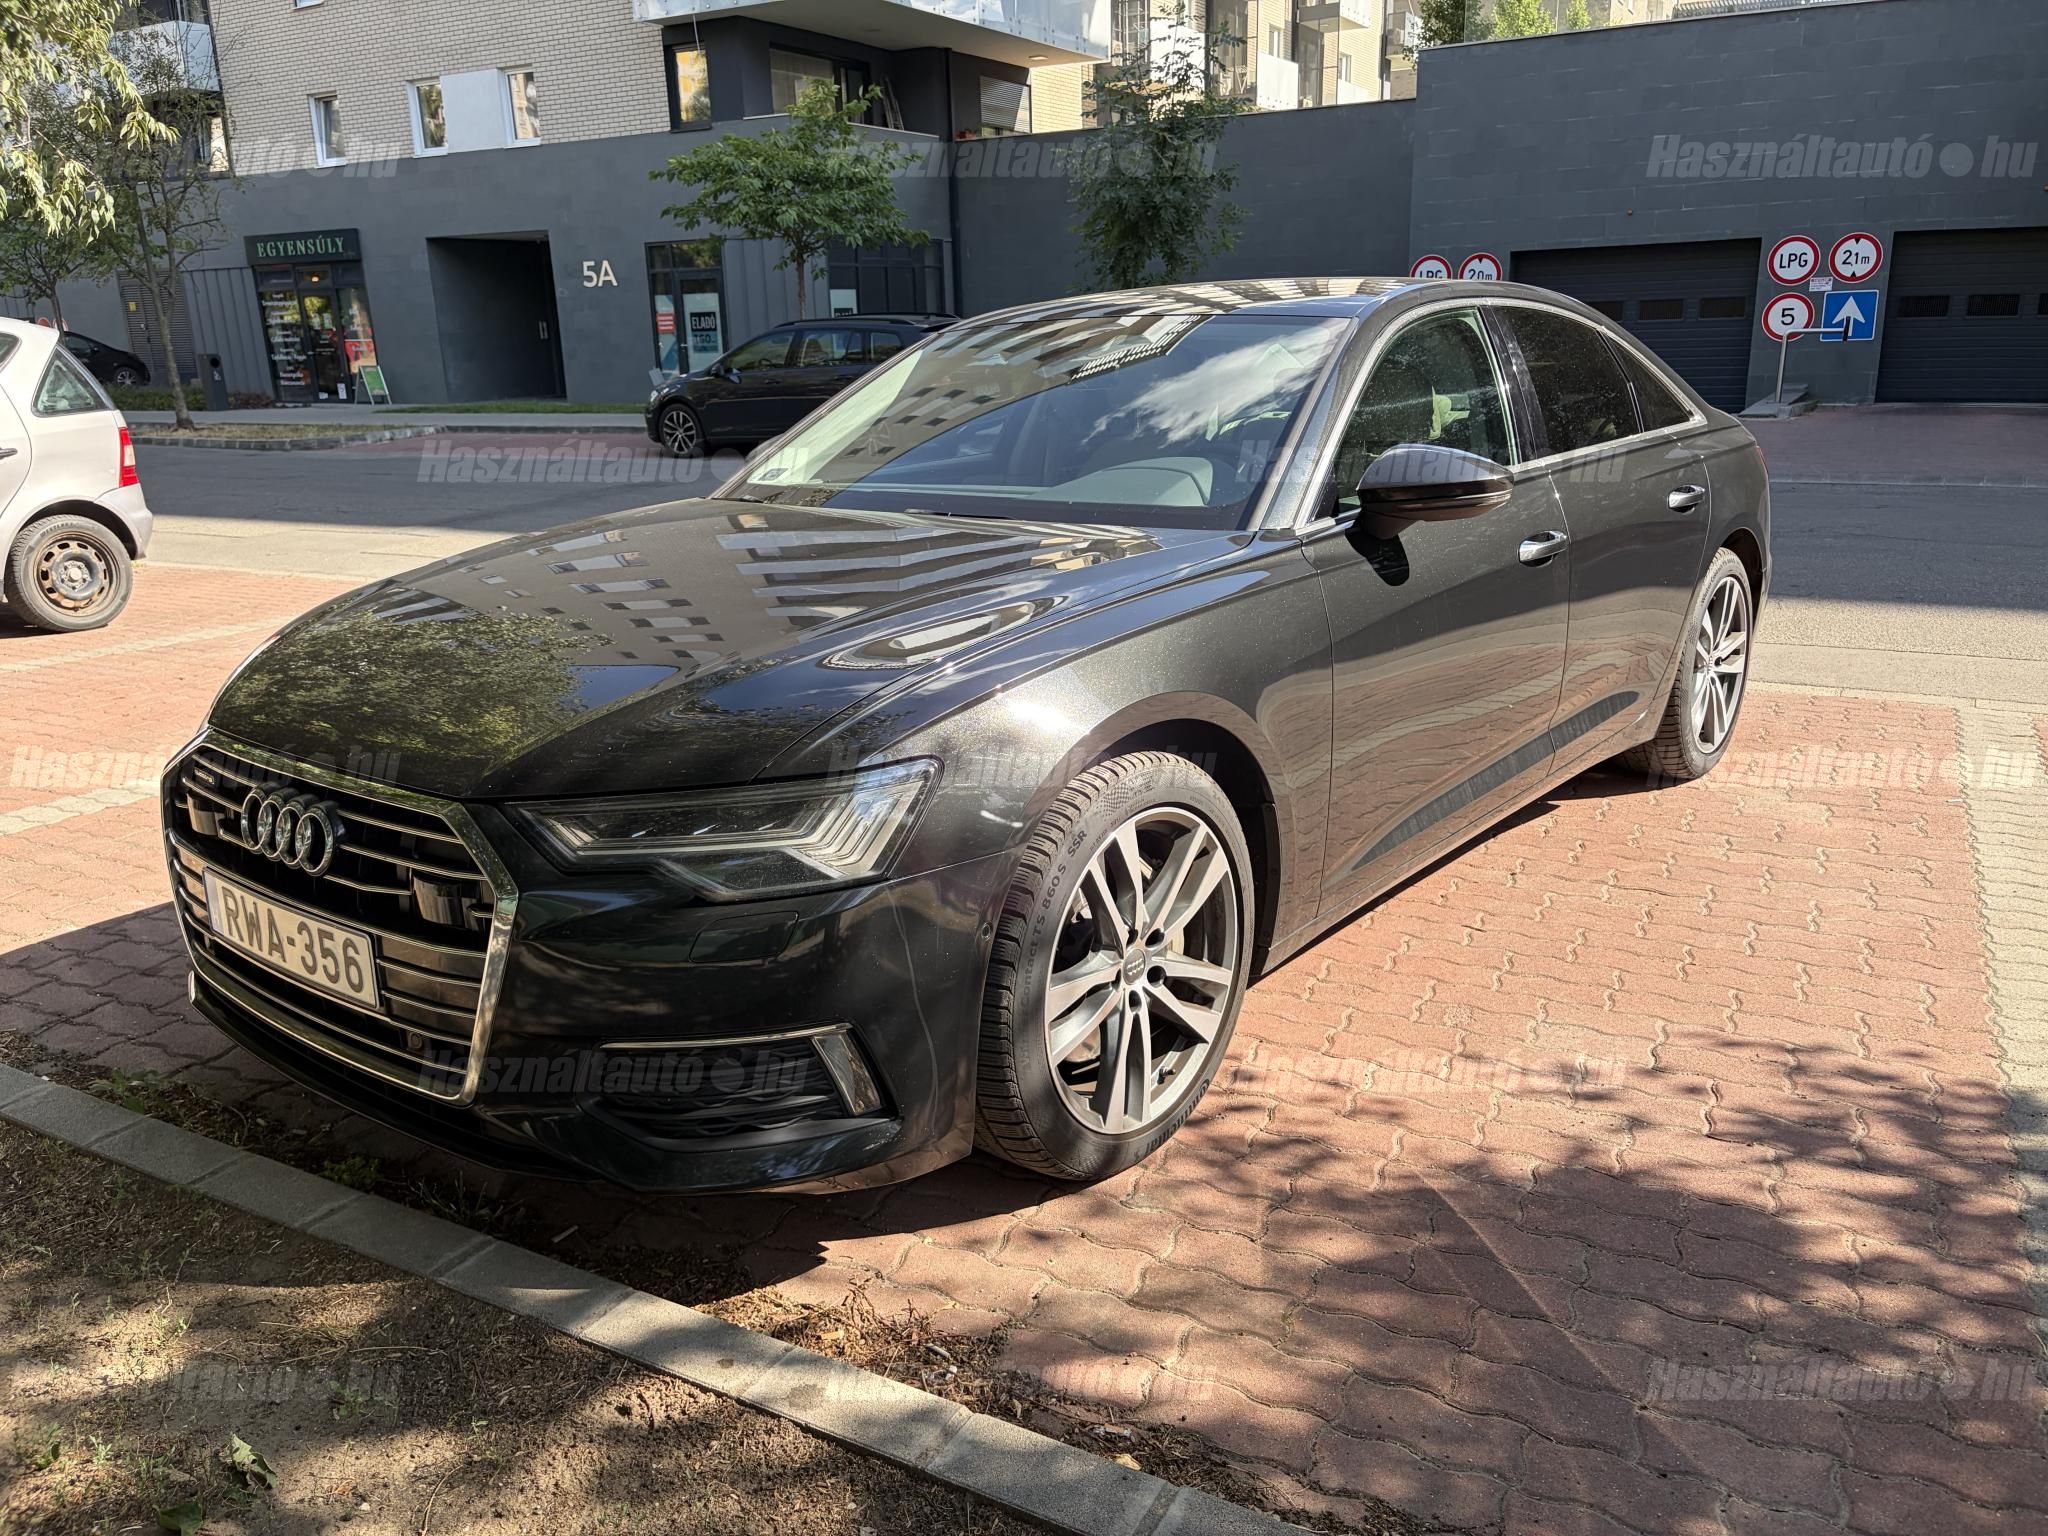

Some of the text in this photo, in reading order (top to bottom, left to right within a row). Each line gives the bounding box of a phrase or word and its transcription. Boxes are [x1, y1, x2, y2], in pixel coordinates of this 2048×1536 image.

[256, 235, 344, 258] EGYENSÚLY
[1779, 252, 1808, 269] LPG
[583, 259, 618, 287] 5A
[691, 314, 716, 329] ELADÓ
[1781, 308, 1795, 325] 5
[1032, 914, 1046, 936] TS
[1067, 830, 1088, 857] SSR
[221, 886, 364, 993] RWA-356
